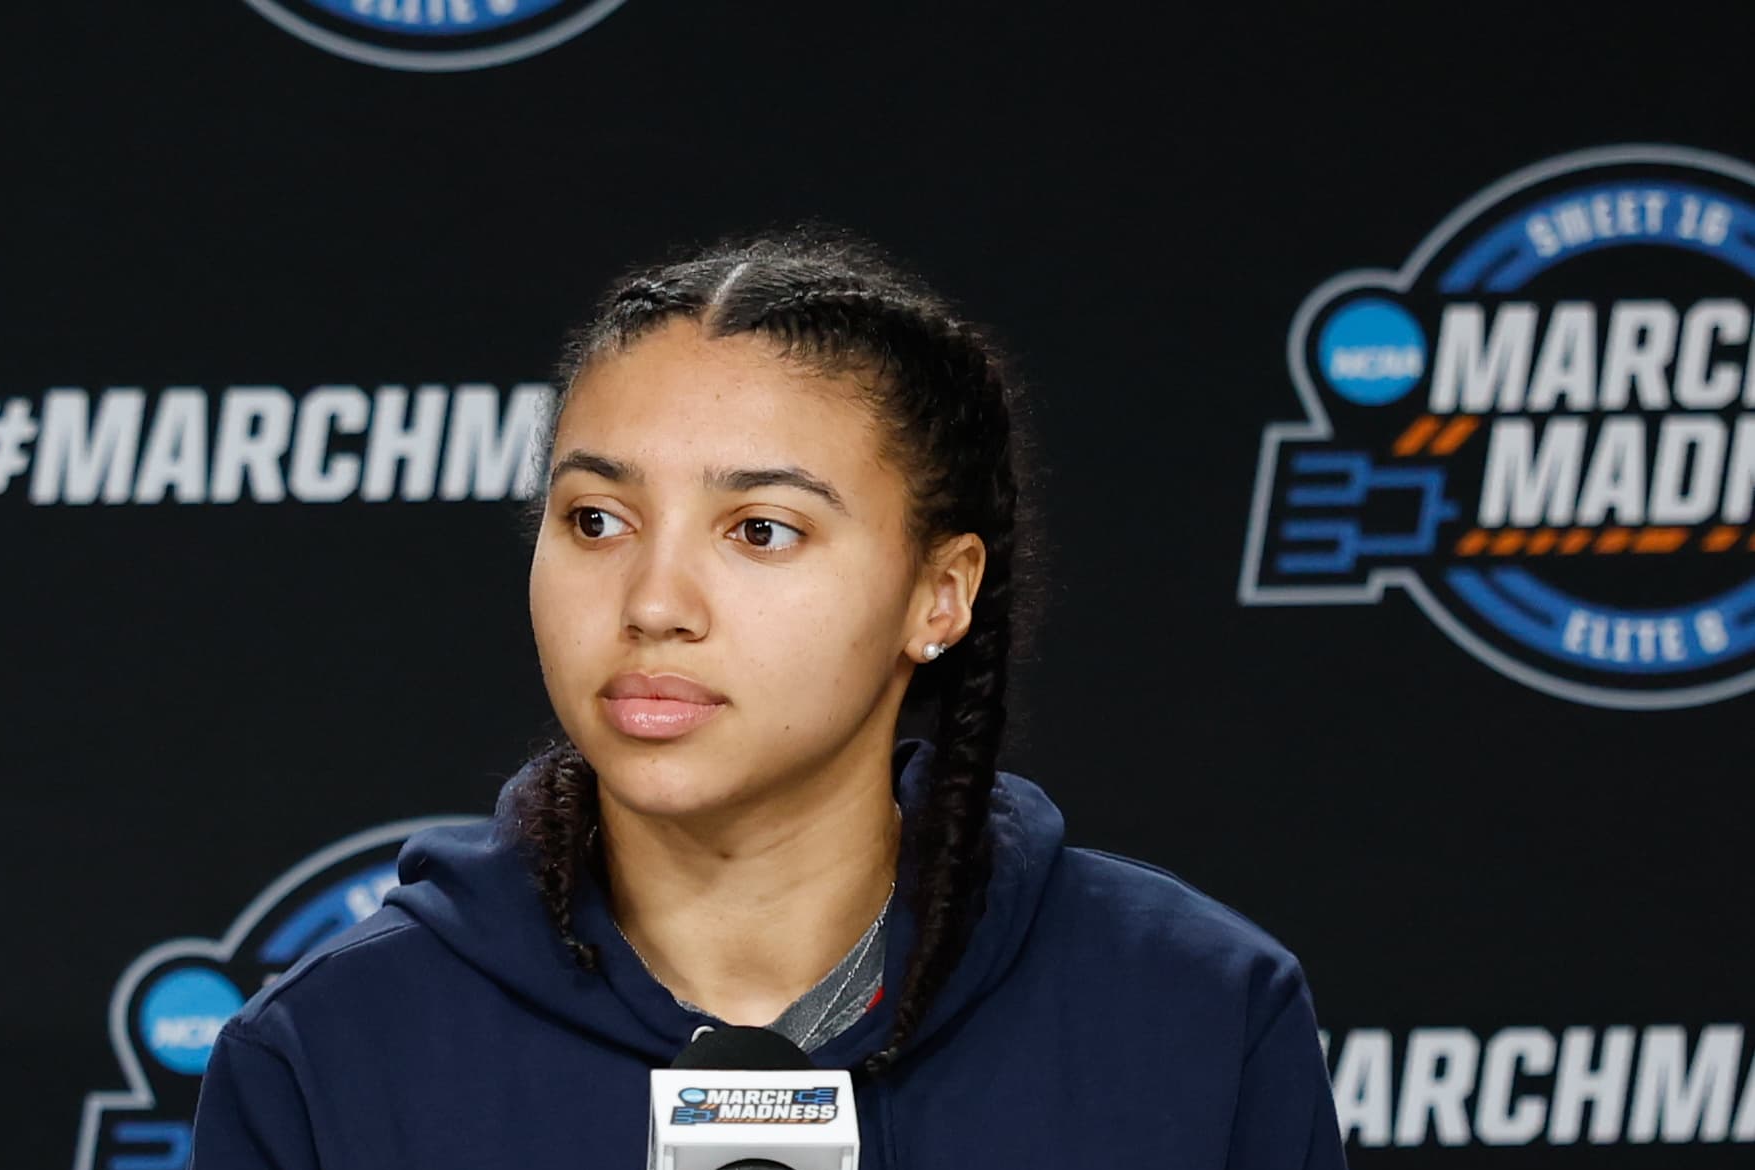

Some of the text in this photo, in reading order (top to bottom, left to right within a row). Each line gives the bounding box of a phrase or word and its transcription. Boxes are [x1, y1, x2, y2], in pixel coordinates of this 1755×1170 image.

[1526, 192, 1732, 257] SWEET 16
[1429, 301, 1755, 412] MARC
[1563, 609, 1686, 662] ELITE
[706, 1089, 795, 1105] MARCH
[717, 1104, 836, 1120] MADNESS
[1320, 1025, 1755, 1147] ARCHM
